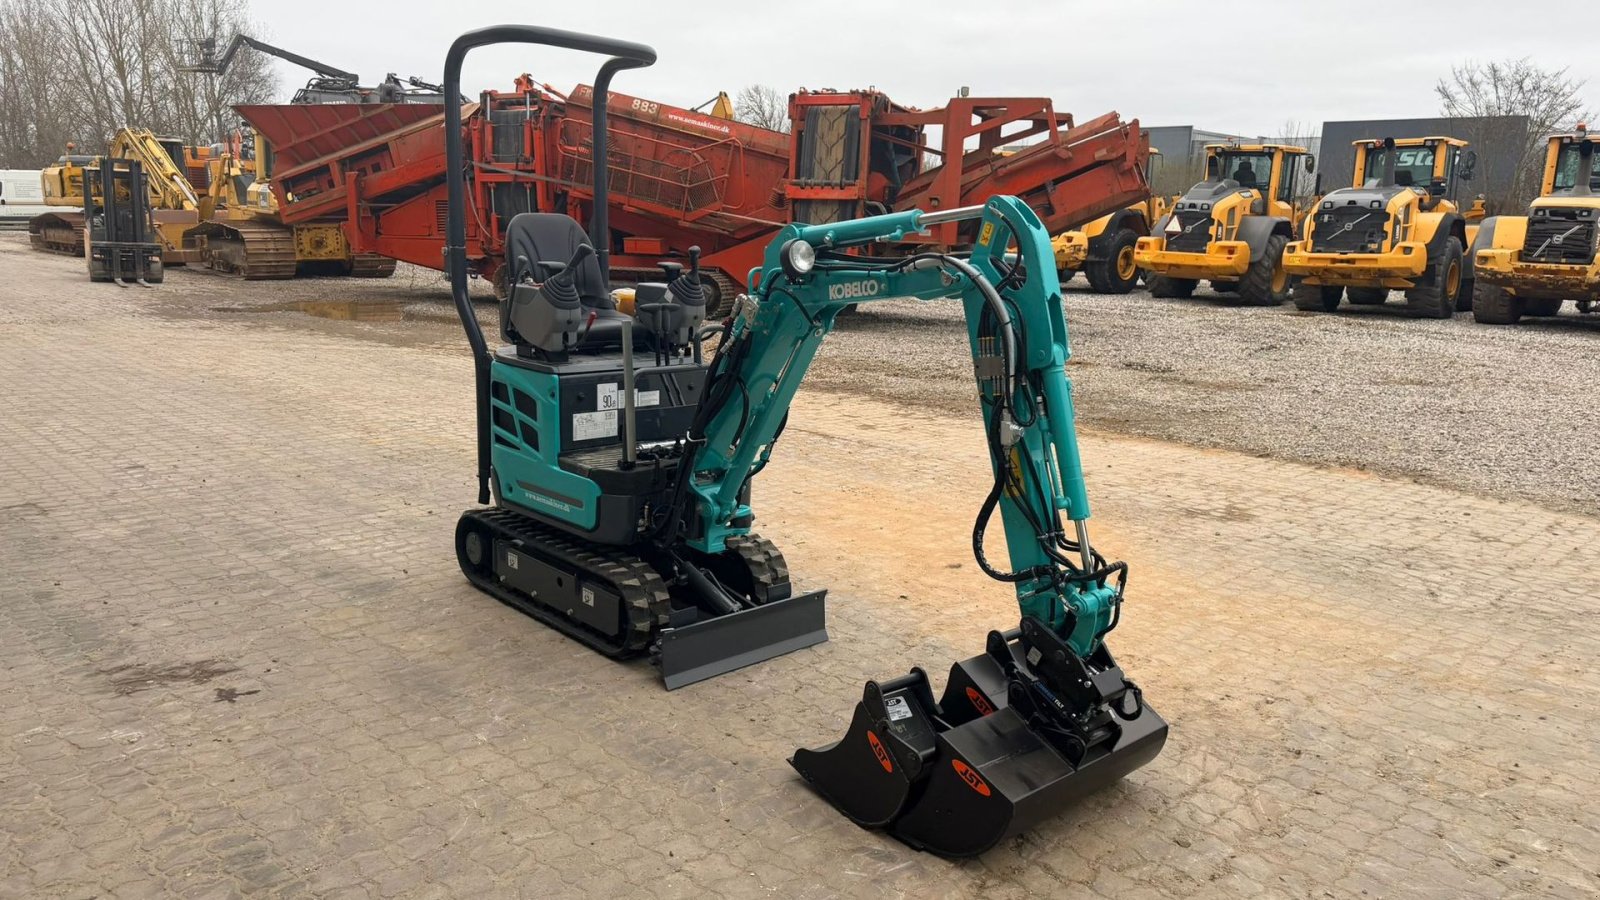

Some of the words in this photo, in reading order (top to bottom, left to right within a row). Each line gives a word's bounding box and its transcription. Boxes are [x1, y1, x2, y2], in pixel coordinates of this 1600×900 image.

[631, 98, 658, 114] 883
[829, 280, 878, 300] KOBELCO
[602, 394, 612, 408] 90
[972, 694, 992, 716] JST
[873, 742, 888, 762] JST
[960, 767, 983, 788] JST
